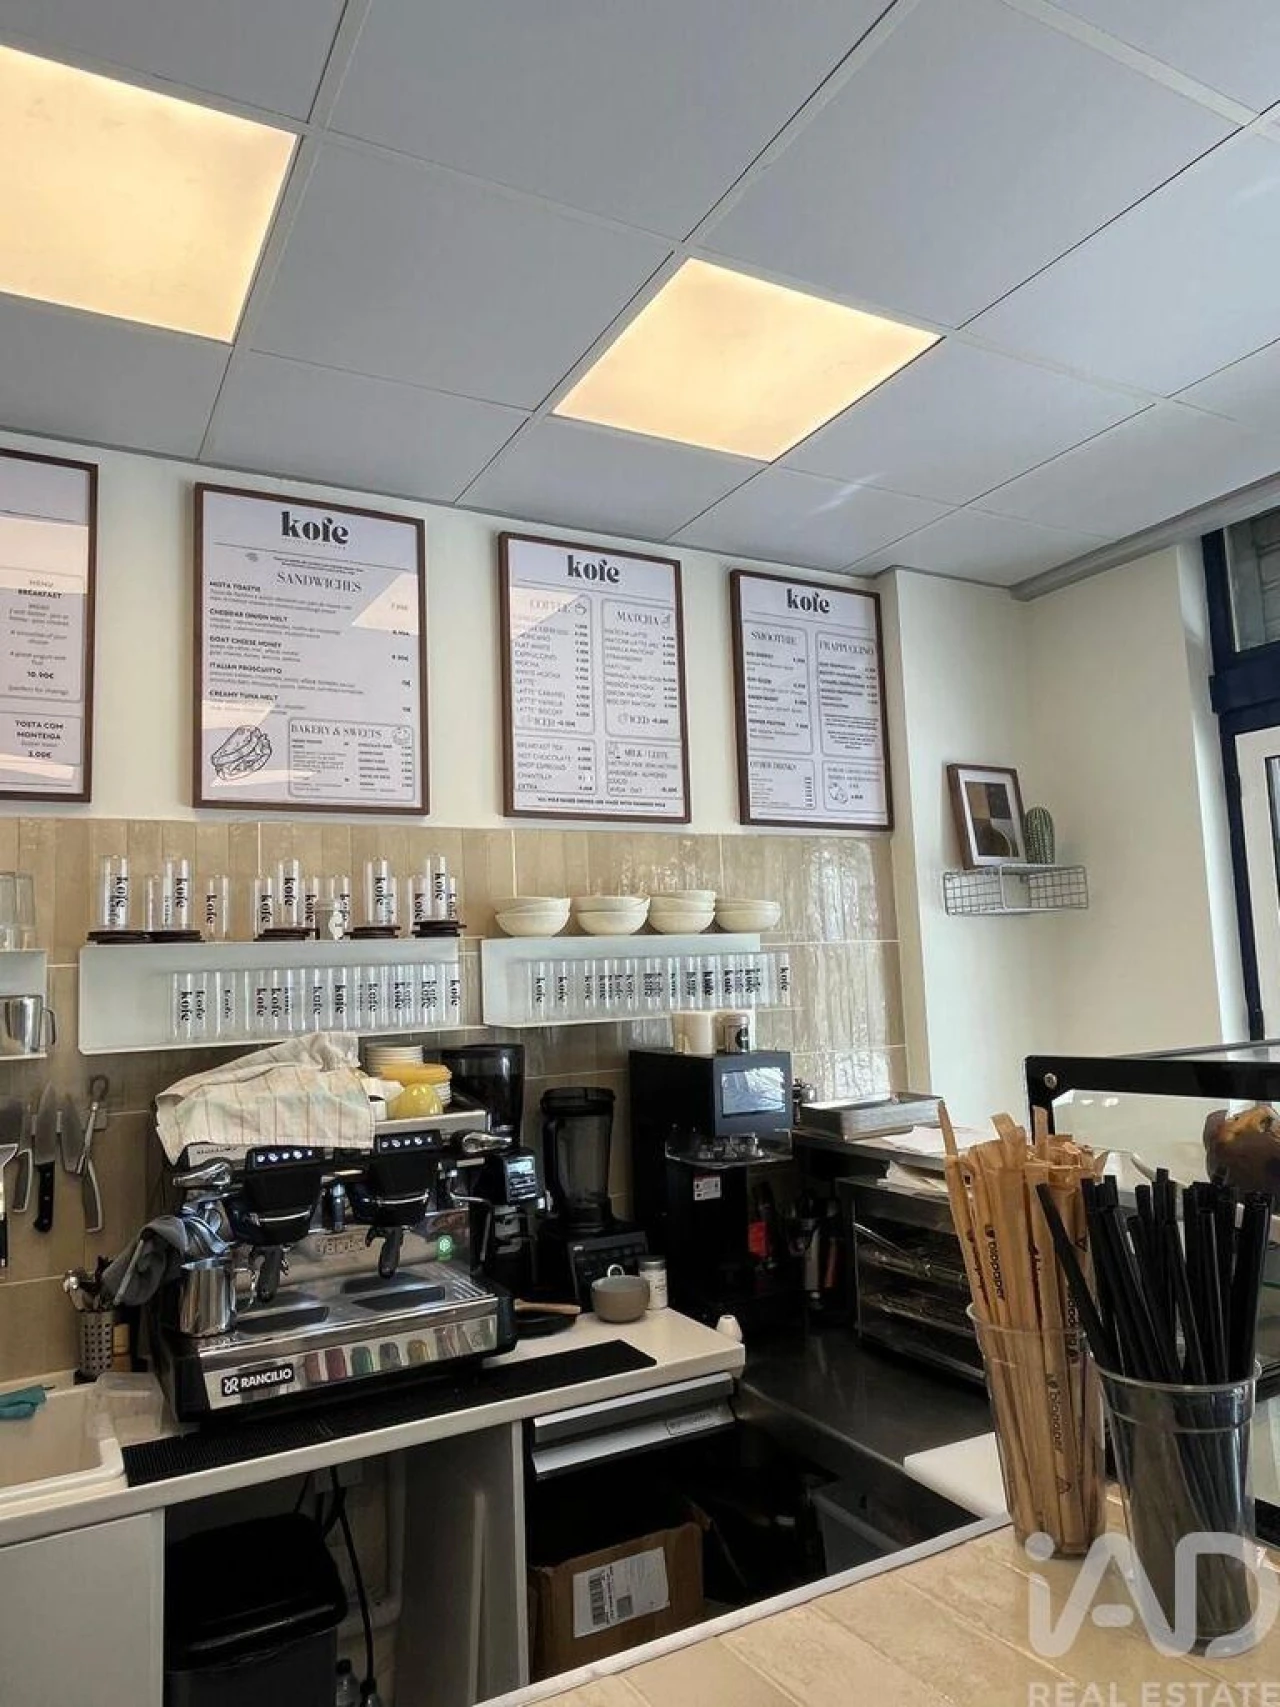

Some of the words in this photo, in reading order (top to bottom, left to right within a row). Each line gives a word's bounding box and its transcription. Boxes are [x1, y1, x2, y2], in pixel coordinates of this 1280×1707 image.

[281, 511, 349, 545] kofe
[277, 571, 362, 593] SANDWICHES
[567, 555, 620, 583] kofe
[18, 590, 62, 599] BREAKFAST
[786, 588, 830, 613] kofe
[617, 611, 660, 626] MATCHA
[15, 720, 42, 728] TOSTA
[42, 722, 63, 730] COM
[291, 724, 331, 736] BAKERY
[344, 727, 382, 738] SWEETS
[284, 877, 296, 906] kofe
[435, 873, 446, 901] kofe
[206, 894, 217, 924] kofe
[261, 894, 273, 923] kofe
[181, 991, 193, 1021] kofe
[271, 988, 283, 1017] kofe
[241, 1368, 293, 1388] RANCILIO
